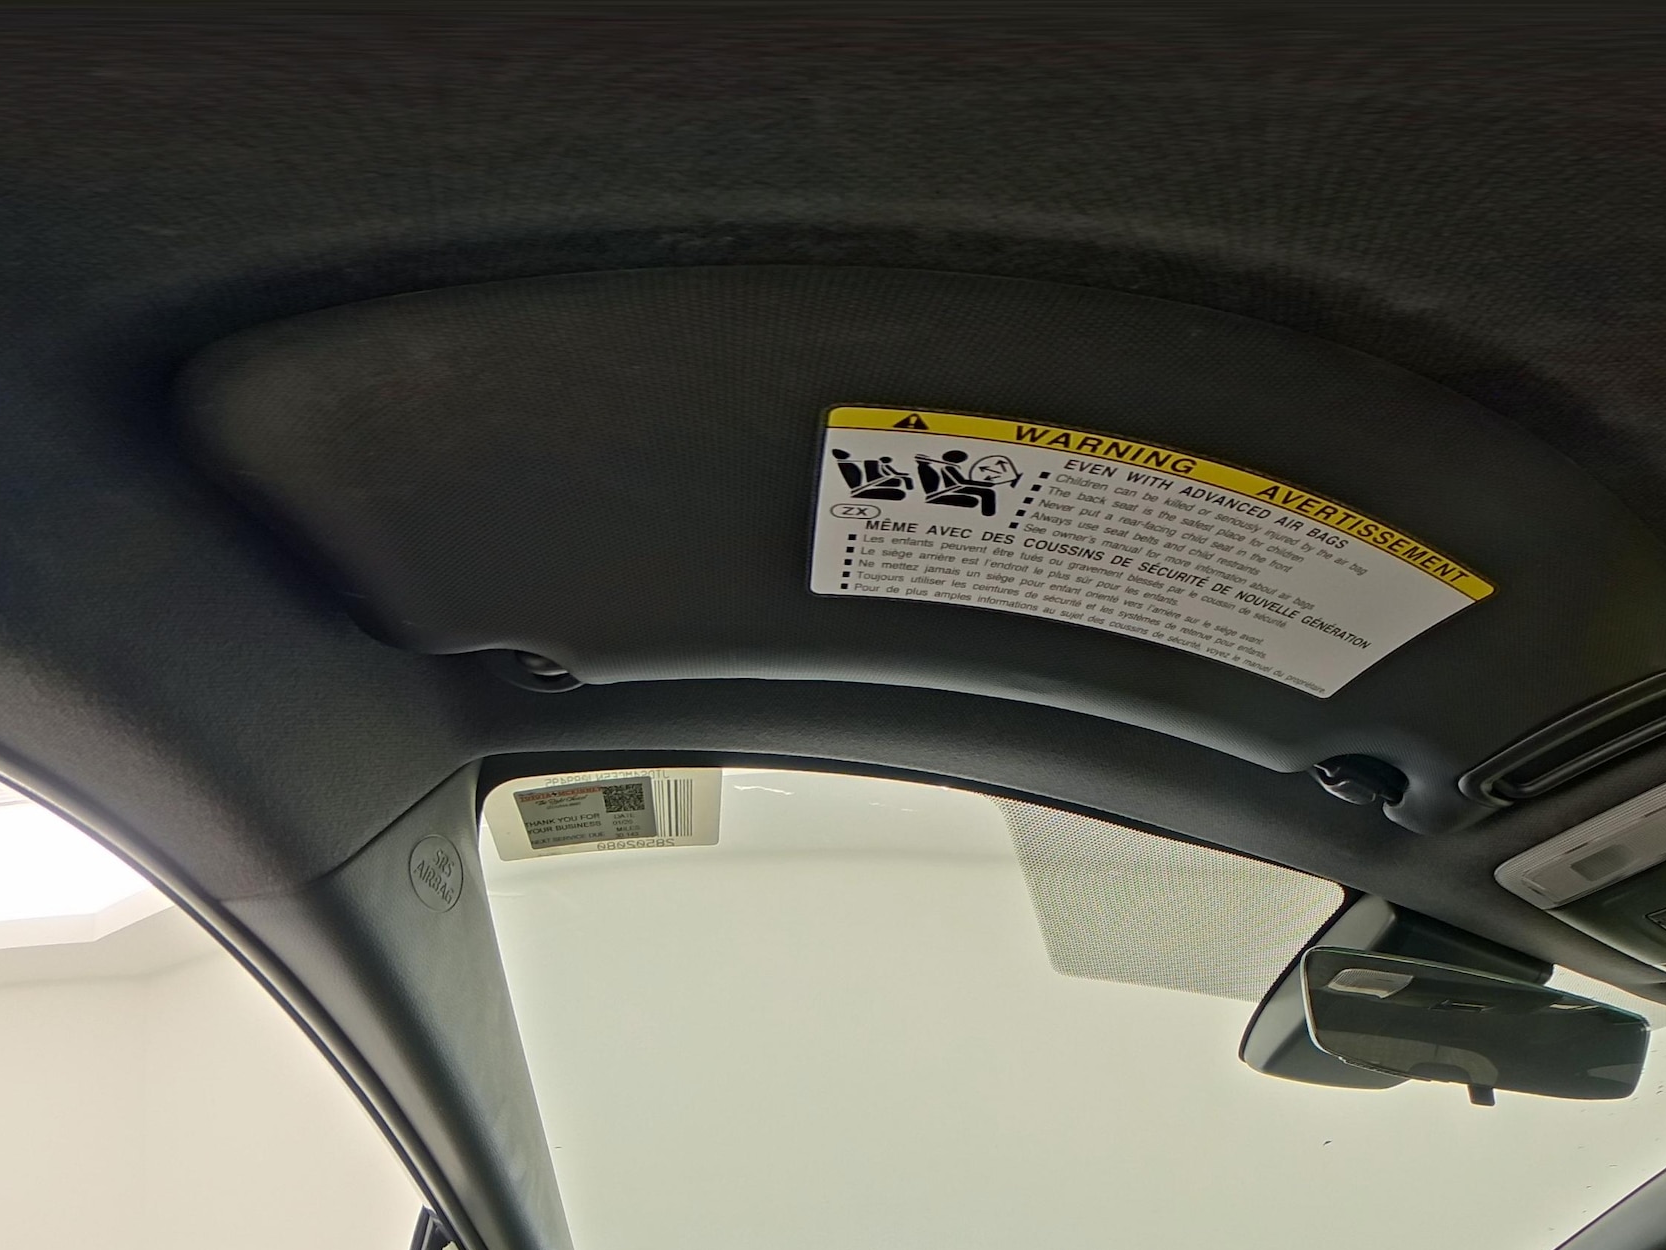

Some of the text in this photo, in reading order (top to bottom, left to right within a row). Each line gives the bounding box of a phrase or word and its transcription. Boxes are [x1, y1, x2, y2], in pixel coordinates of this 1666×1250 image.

[1016, 426, 1197, 475] WARNING
[841, 507, 868, 516] ZX
[1038, 499, 1075, 511] Never
[1079, 507, 1101, 521] put
[1119, 515, 1177, 537] rear-facing
[1181, 531, 1208, 544] child
[1212, 538, 1236, 551] seat
[1237, 547, 1248, 557] in
[1250, 551, 1267, 563] the
[1269, 558, 1293, 572] front
[1048, 486, 1305, 562] The back seat is the safest place for children
[1056, 474, 1369, 576] Children can be killed or seriously injured by the air bag
[1064, 459, 1349, 549] EVEN WITH ADVANCED AIR BAGS
[1255, 485, 1470, 583] AVERTISSEMENT
[863, 535, 885, 544] Les
[891, 537, 934, 548] enfants
[940, 542, 987, 555] peuvent
[993, 547, 1015, 558] être
[1020, 552, 1044, 563] tués
[1049, 558, 1064, 566] ou
[1068, 561, 1124, 579] gravement
[1127, 574, 1164, 589] blessés
[1167, 584, 1186, 595] par
[1188, 590, 1198, 599] le
[1201, 595, 1237, 610] coussin
[1238, 606, 1252, 615] de
[1024, 523, 1315, 611] See owner's manual for more information about air bags
[1030, 511, 1261, 576] Always use seat belts and child restraints
[866, 518, 1372, 650] MÊME AVEC DES COUSSINS DE SÉCURITÉ DE NOUVELLE GÉNÉRATION
[525, 819, 555, 828] THANK
[556, 821, 601, 831] BUSINESS
[414, 860, 454, 904] AIRBAG
[435, 848, 454, 877] SRS
